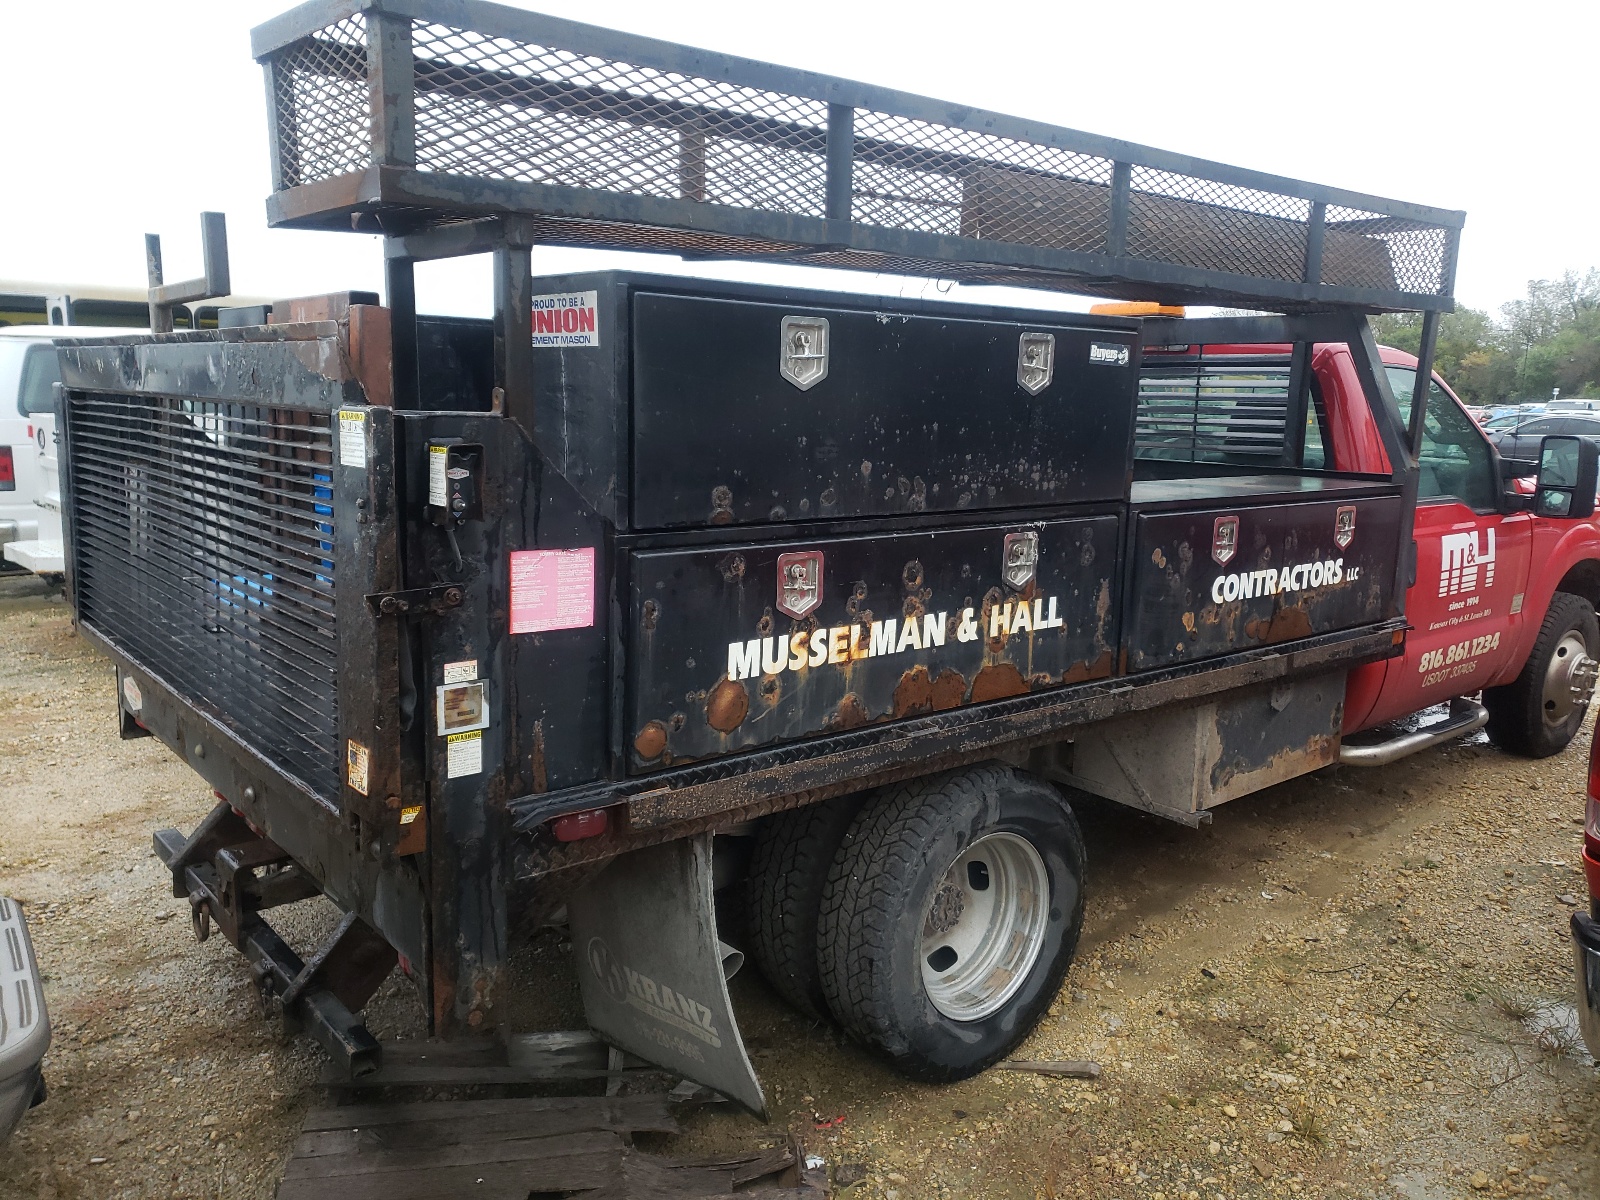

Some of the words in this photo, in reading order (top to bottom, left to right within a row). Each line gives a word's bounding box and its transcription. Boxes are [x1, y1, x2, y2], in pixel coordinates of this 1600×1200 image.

[557, 297, 567, 308] TO
[569, 297, 578, 307] BE
[580, 296, 585, 306] A
[560, 335, 591, 344] MASON
[1090, 344, 1118, 361] Buyers
[1211, 557, 1344, 604] CONTRACTORS
[1346, 567, 1360, 581] LLC
[1448, 601, 1465, 611] since
[727, 611, 947, 682] MUSSELMAN
[957, 607, 979, 643] &
[989, 596, 1063, 638] HALL
[1418, 631, 1501, 673] 816.861.1234
[1421, 668, 1451, 688] USDOT
[454, 730, 481, 742] WARNING
[623, 965, 719, 1036] KRANZ
